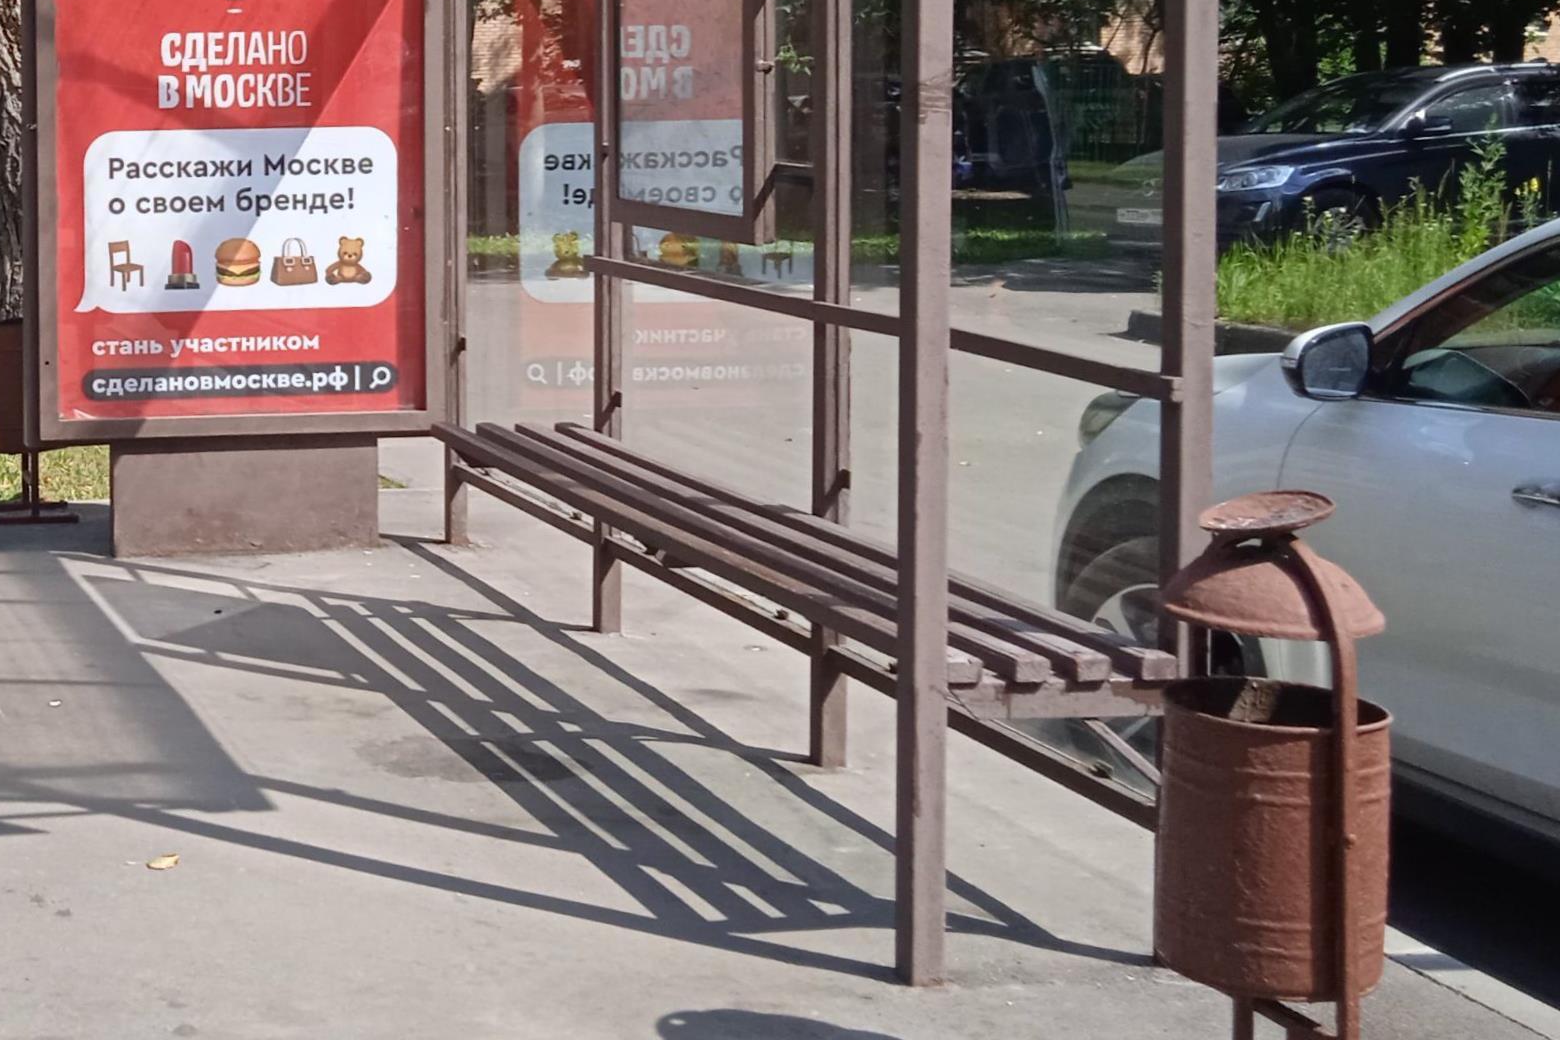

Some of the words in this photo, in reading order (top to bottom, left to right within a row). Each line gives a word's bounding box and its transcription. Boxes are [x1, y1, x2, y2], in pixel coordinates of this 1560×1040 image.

[160, 30, 308, 73] СДЕЛАНО
[158, 75, 180, 109] В
[186, 72, 313, 108] МОСКВЕ
[108, 156, 253, 179] Расскажи
[264, 154, 374, 176] Москве
[108, 195, 126, 214] о
[135, 192, 226, 214] своем
[235, 187, 355, 217] бренде!
[91, 338, 163, 356] стань
[171, 334, 320, 358] участником
[91, 366, 348, 396] сделановмоскве.рф
